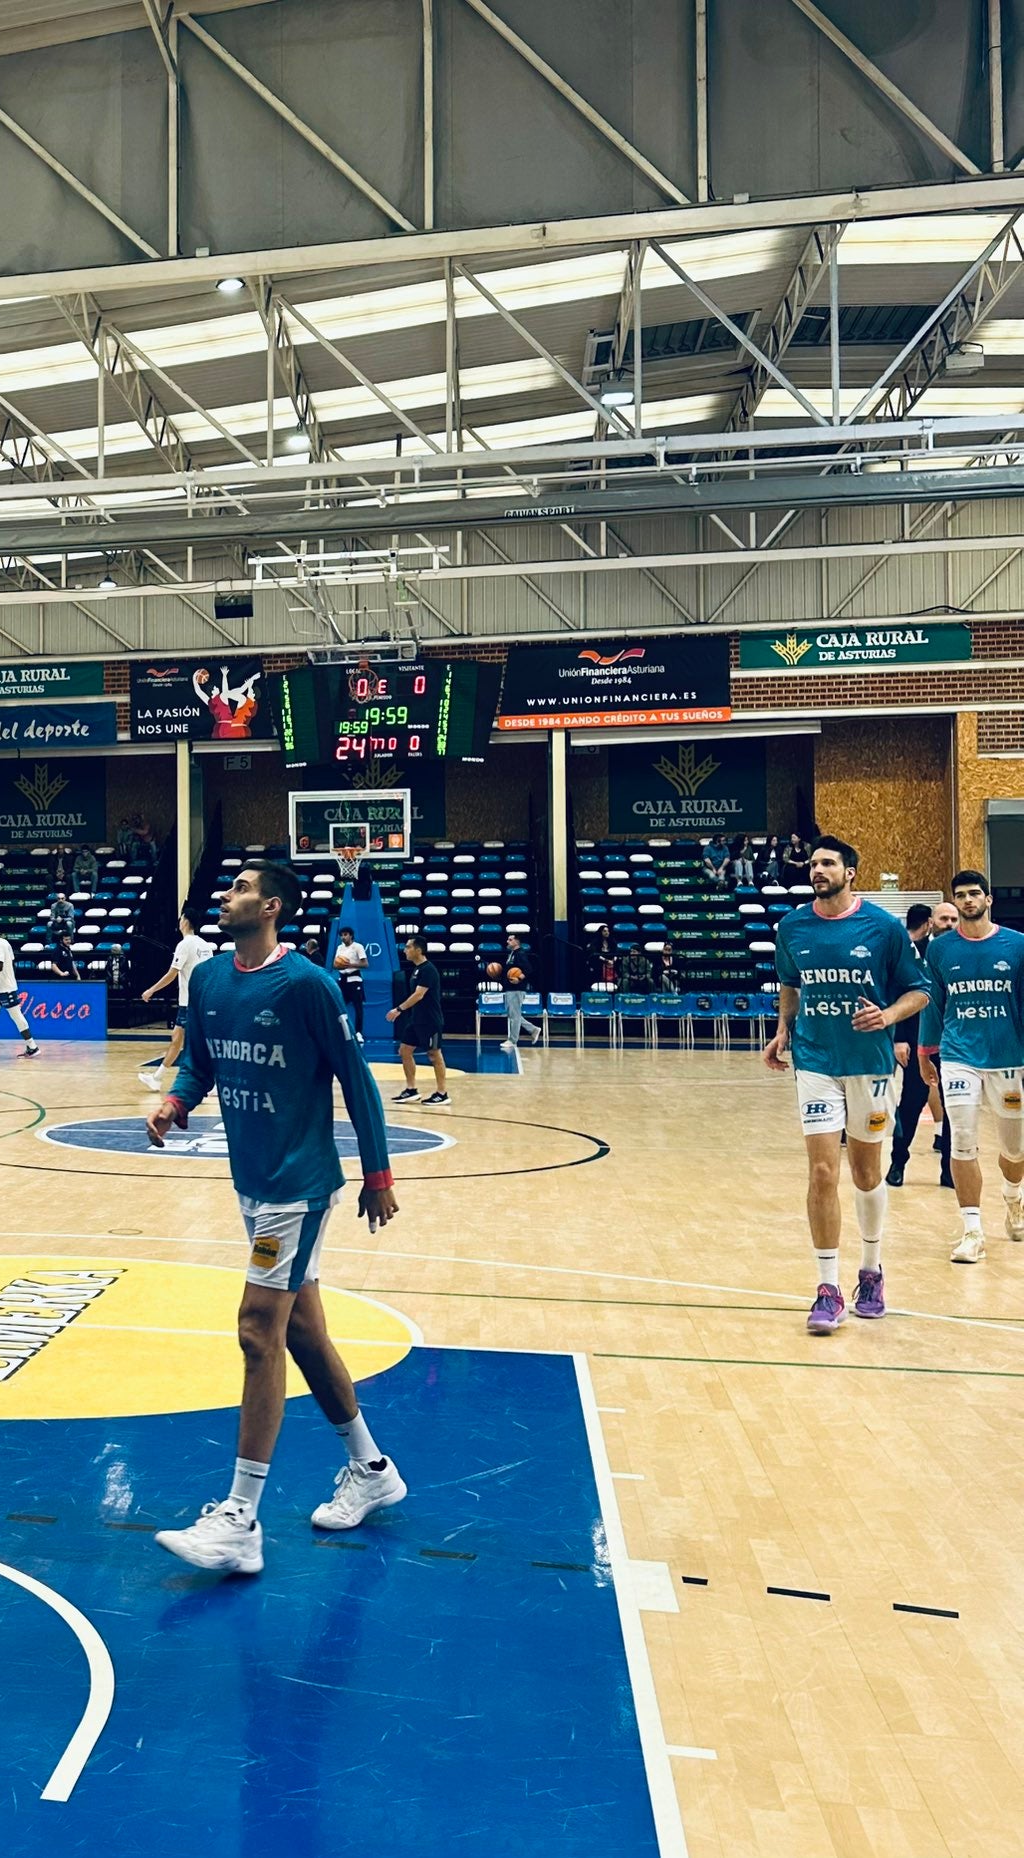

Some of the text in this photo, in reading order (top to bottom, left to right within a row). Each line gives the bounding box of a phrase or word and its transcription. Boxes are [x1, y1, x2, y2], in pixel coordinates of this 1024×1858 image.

[816, 629, 929, 649] CAJA RURAL
[818, 648, 896, 661] DE ASTURIAS
[20, 668, 70, 682] RURAL
[591, 676, 632, 686] Desde 1984
[357, 678, 368, 697] 0
[378, 679, 387, 694] E
[414, 675, 426, 694] 0
[526, 691, 697, 706] WWW.UNIONFINANCIERA.ES
[137, 706, 200, 719] LA PASIÓN
[365, 706, 408, 726] 19:59
[504, 708, 723, 728] DESDE 1984 DANDO CRÉDITO A TUS SUEÑOS
[23, 719, 90, 743] deporte
[137, 724, 189, 735] NOS UNE
[339, 721, 369, 734] 19:59
[336, 736, 366, 760] 24
[388, 737, 397, 750] 0
[409, 735, 420, 750] 0
[632, 799, 743, 816] CAJA RURAL
[36, 813, 87, 827] RURAL
[649, 816, 726, 827] DE ASTURIAS
[10, 829, 73, 839] DE ASTURIAS
[948, 979, 1012, 996] MENORCA
[872, 1078, 888, 1097] 77
[948, 1081, 965, 1089] HR
[806, 1103, 827, 1115] HR
